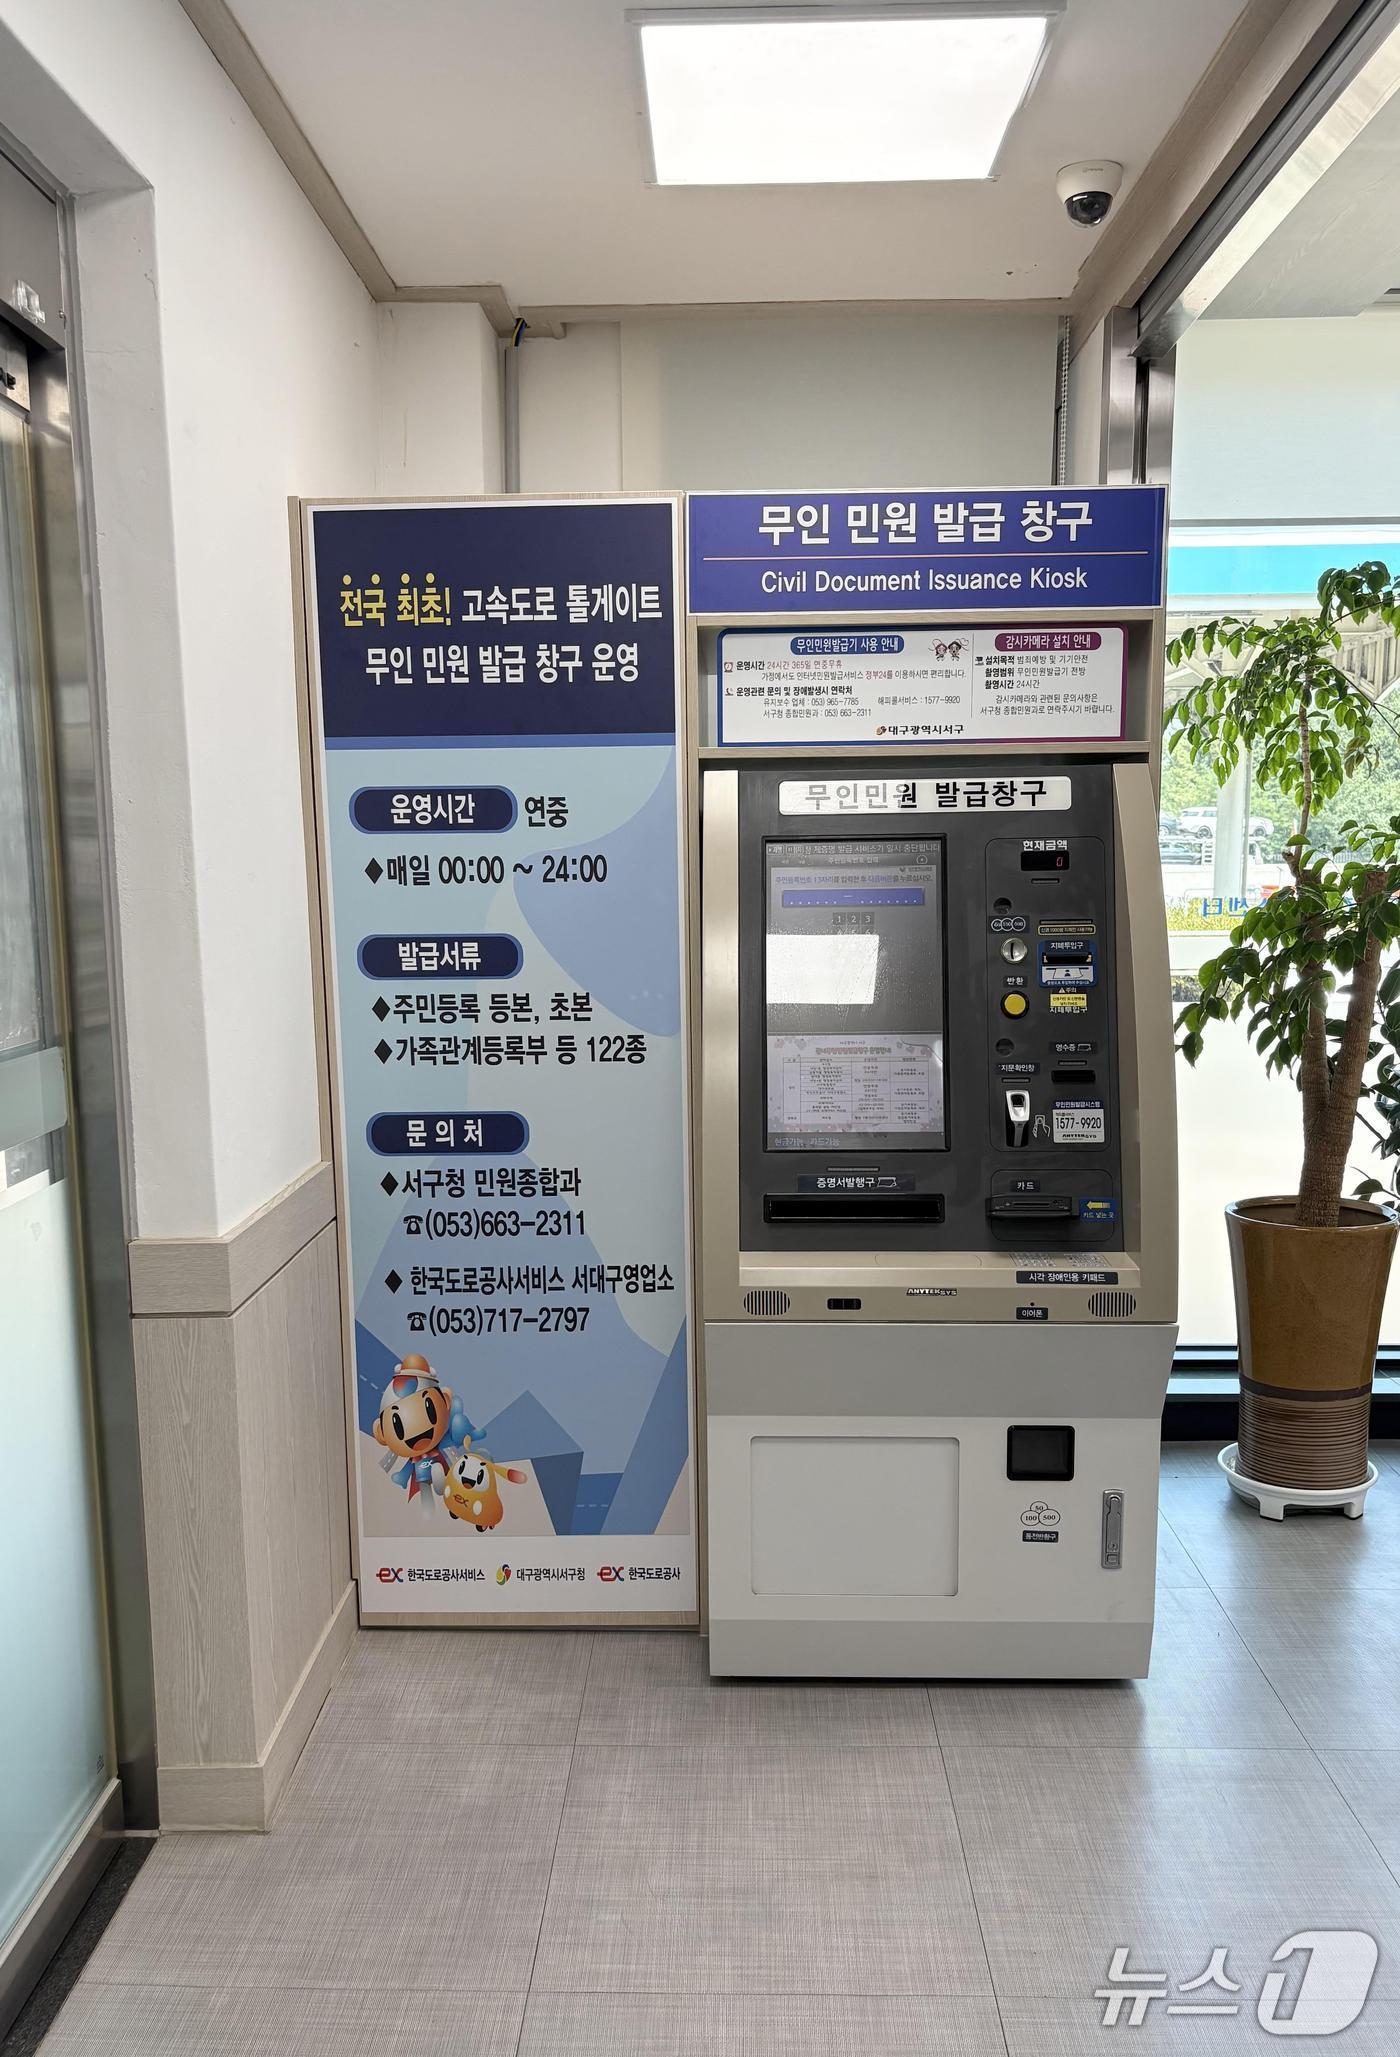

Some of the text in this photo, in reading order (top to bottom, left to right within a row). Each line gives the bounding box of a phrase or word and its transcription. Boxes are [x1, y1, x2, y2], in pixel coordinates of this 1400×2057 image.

[756, 500, 1094, 548] 무인 민원 발급 창구
[761, 566, 1089, 594] Civil Document Issuance Kiosk
[339, 572, 663, 627] 전국 최초! 고속도로 톨게이트
[795, 636, 899, 653] 무인민원발급기 사용 안내
[1006, 633, 1091, 649] 감시카메라 설치 안내
[365, 642, 640, 686] 무인 민원 발급 창구 운영
[737, 660, 842, 671] 운영시간 24시간 365일 연중무휴
[986, 656, 1014, 665] 설치목적
[1016, 655, 1047, 665] 범죄예방
[735, 686, 852, 697] 운영관련 문의 및 장애발생시 연락처
[1017, 680, 1039, 688] 24시간
[764, 698, 789, 706] 유지보수
[827, 698, 859, 706] 965-7785
[925, 696, 960, 704] 1577-9920
[764, 710, 783, 718] 서구청
[840, 708, 871, 716] 663-2311
[888, 724, 964, 735] 대구광역시서구
[809, 780, 1047, 810] 무인민원 발급창구
[390, 793, 476, 825] 운영시간
[524, 795, 569, 829] 연중
[1022, 840, 1068, 851] 현재금액
[385, 852, 431, 888] 매일
[438, 855, 505, 885] 00:00
[542, 854, 608, 883] 24:00
[398, 941, 482, 971] 발급서류
[393, 991, 593, 1025] 주민등록 등본, 초본
[395, 1033, 647, 1067] 가족관계등록부 등 122종
[1055, 1117, 1102, 1129] 1577-9920
[401, 1165, 584, 1199] 서구청 민원종합과
[816, 1177, 876, 1189] 증명서발행구
[425, 1208, 586, 1241] (053)663-2311
[410, 1263, 675, 1296] 한국도로공사서비스 서대구영업소
[1029, 1272, 1045, 1282] 시각
[428, 1305, 590, 1337] (053)717-2797
[1021, 1308, 1043, 1318] 이어폰
[407, 1568, 486, 1582] 한국도로공사서비스
[516, 1567, 586, 1582] 대구광역시서구청
[628, 1566, 681, 1581] 한국도로공사
